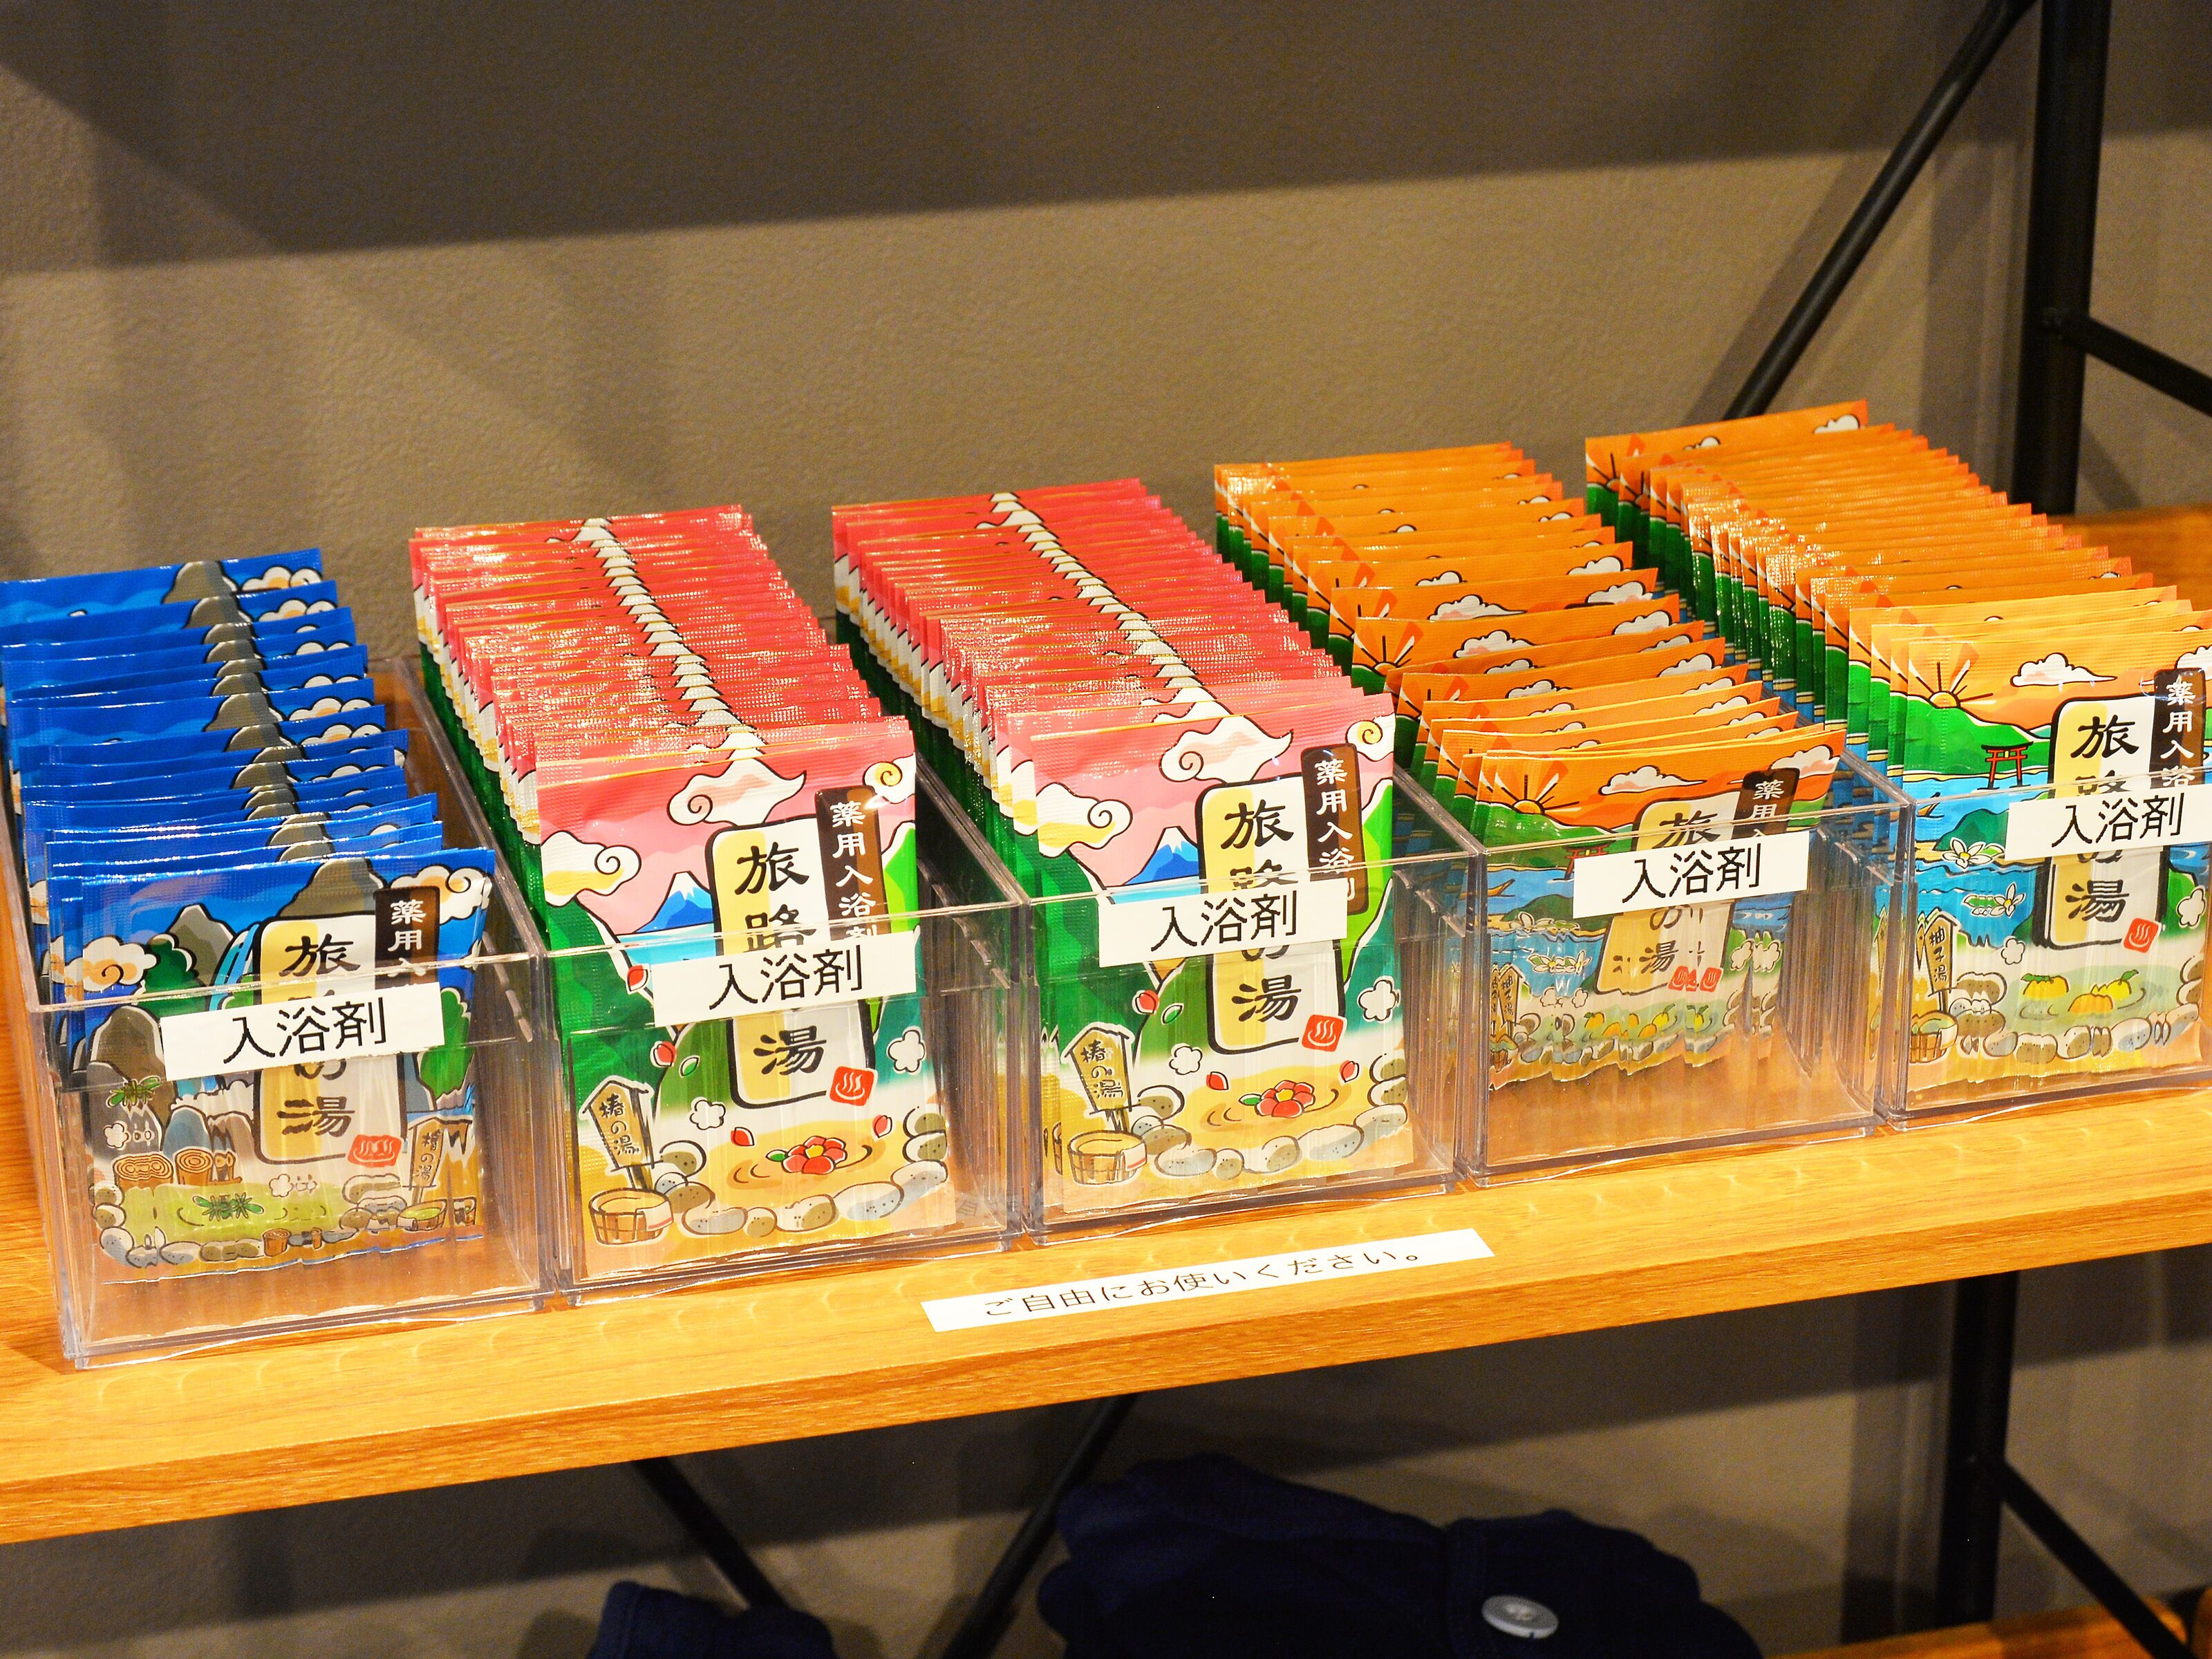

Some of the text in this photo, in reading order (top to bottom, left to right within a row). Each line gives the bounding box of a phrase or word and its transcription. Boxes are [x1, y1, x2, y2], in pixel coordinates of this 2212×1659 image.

[2051, 792, 2185, 848] 入浴剤
[1622, 843, 1761, 904] 入浴剤
[1150, 890, 1297, 953] 入浴剤
[709, 944, 863, 1011] 入浴剤
[223, 997, 386, 1065] 入浴剤
[1080, 1040, 1123, 1099] 椿の湯
[599, 1094, 639, 1156] 椿の湯
[984, 1250, 1418, 1317] ご自由にお使いください。
